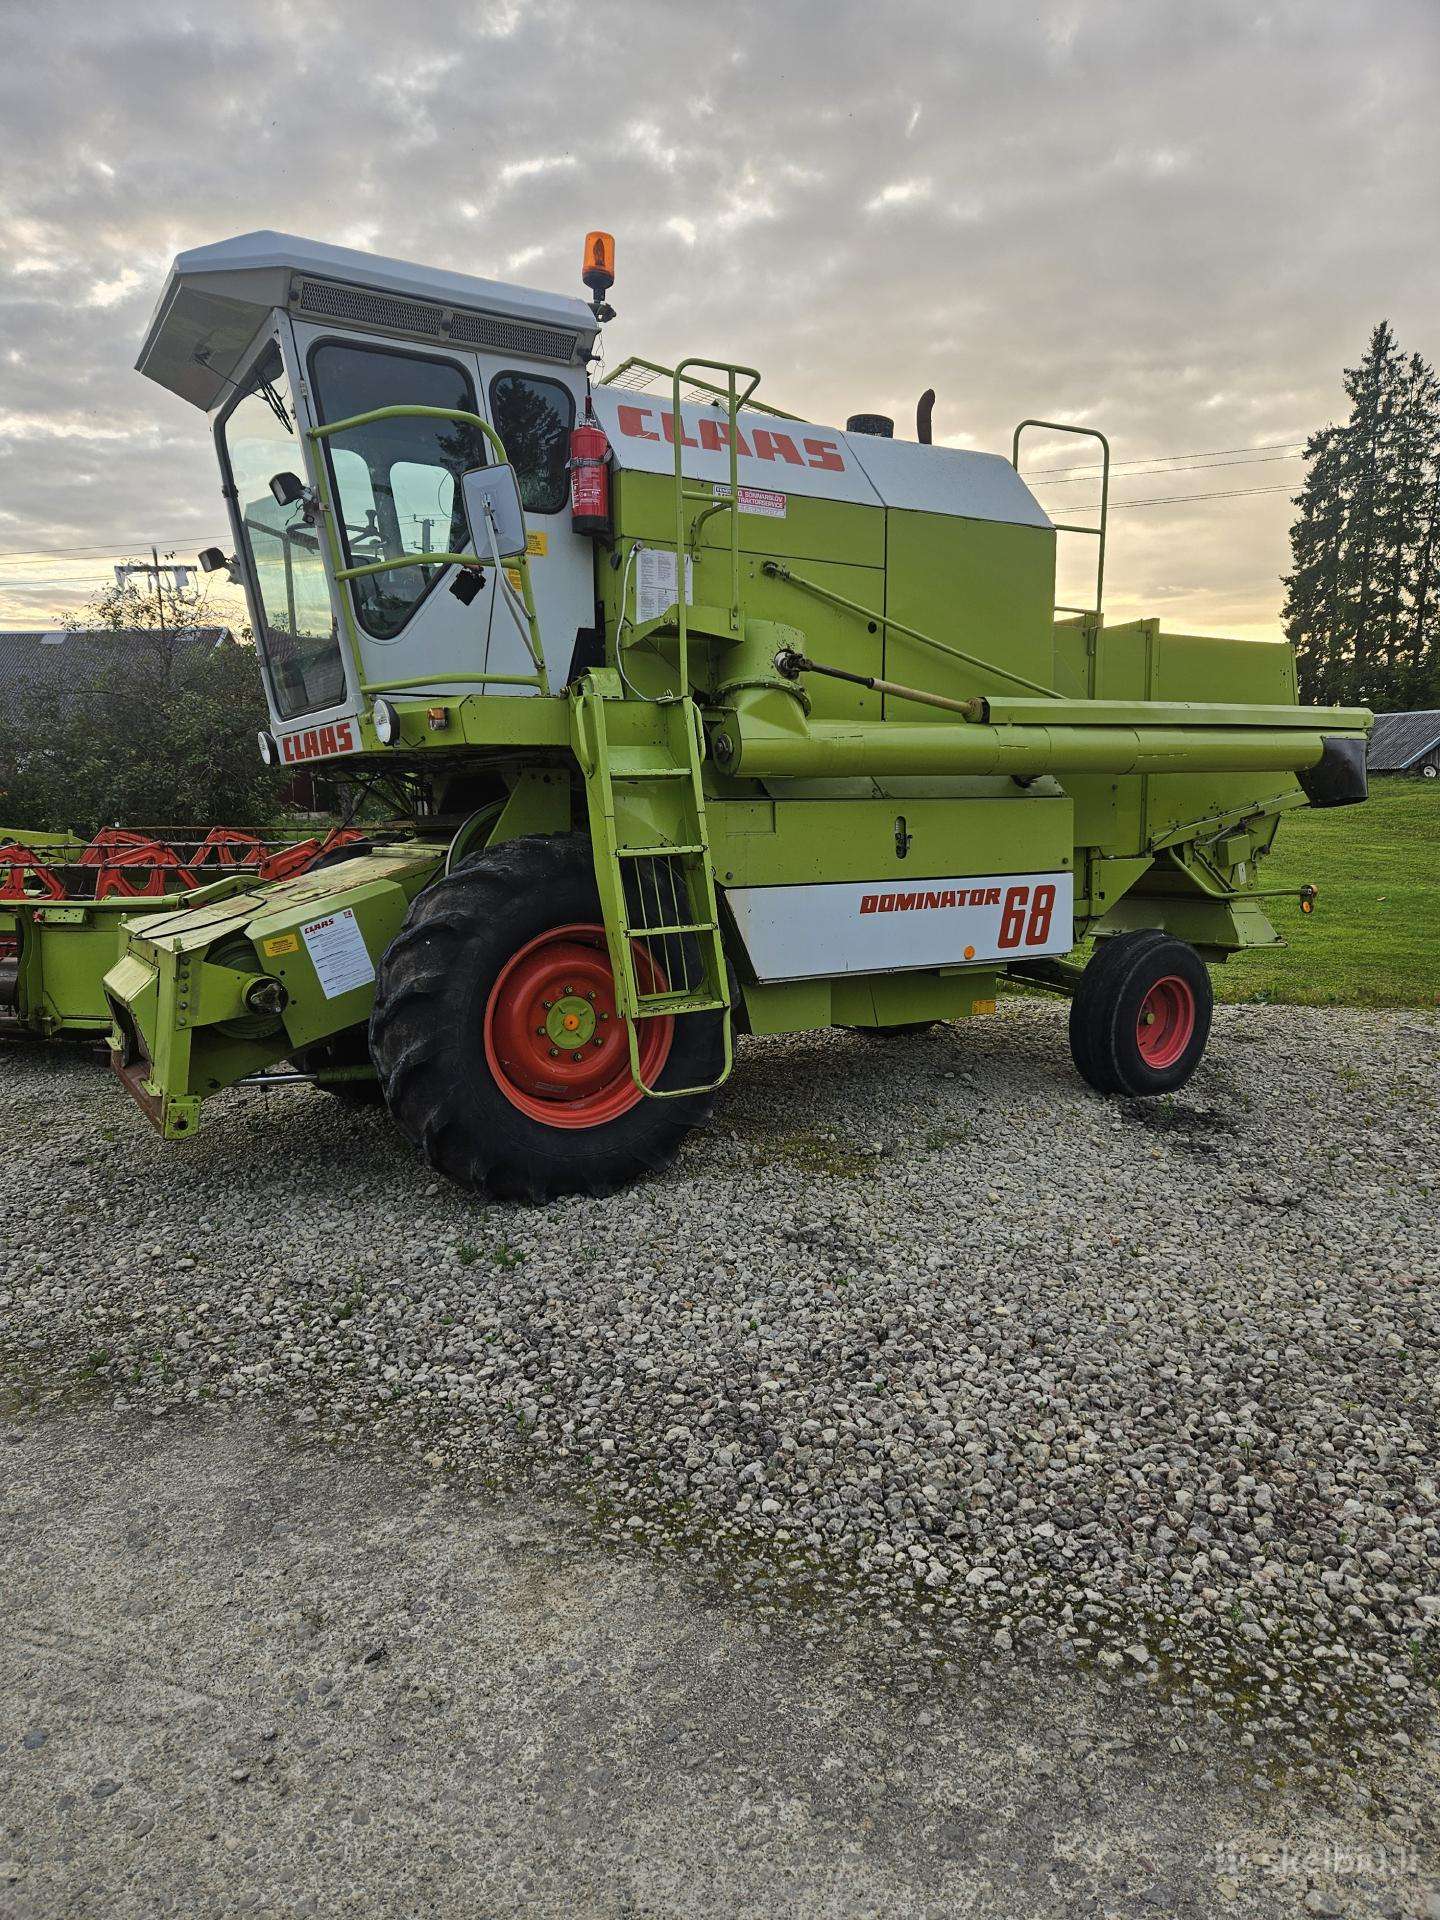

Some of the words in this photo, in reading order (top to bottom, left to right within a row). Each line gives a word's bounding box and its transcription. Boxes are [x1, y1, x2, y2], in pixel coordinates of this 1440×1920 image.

[617, 405, 845, 472] CLAAS
[283, 723, 353, 761] CLAAS
[304, 918, 335, 934] CLAAS
[860, 887, 1001, 914] DOMINATOR
[998, 885, 1056, 948] 68
